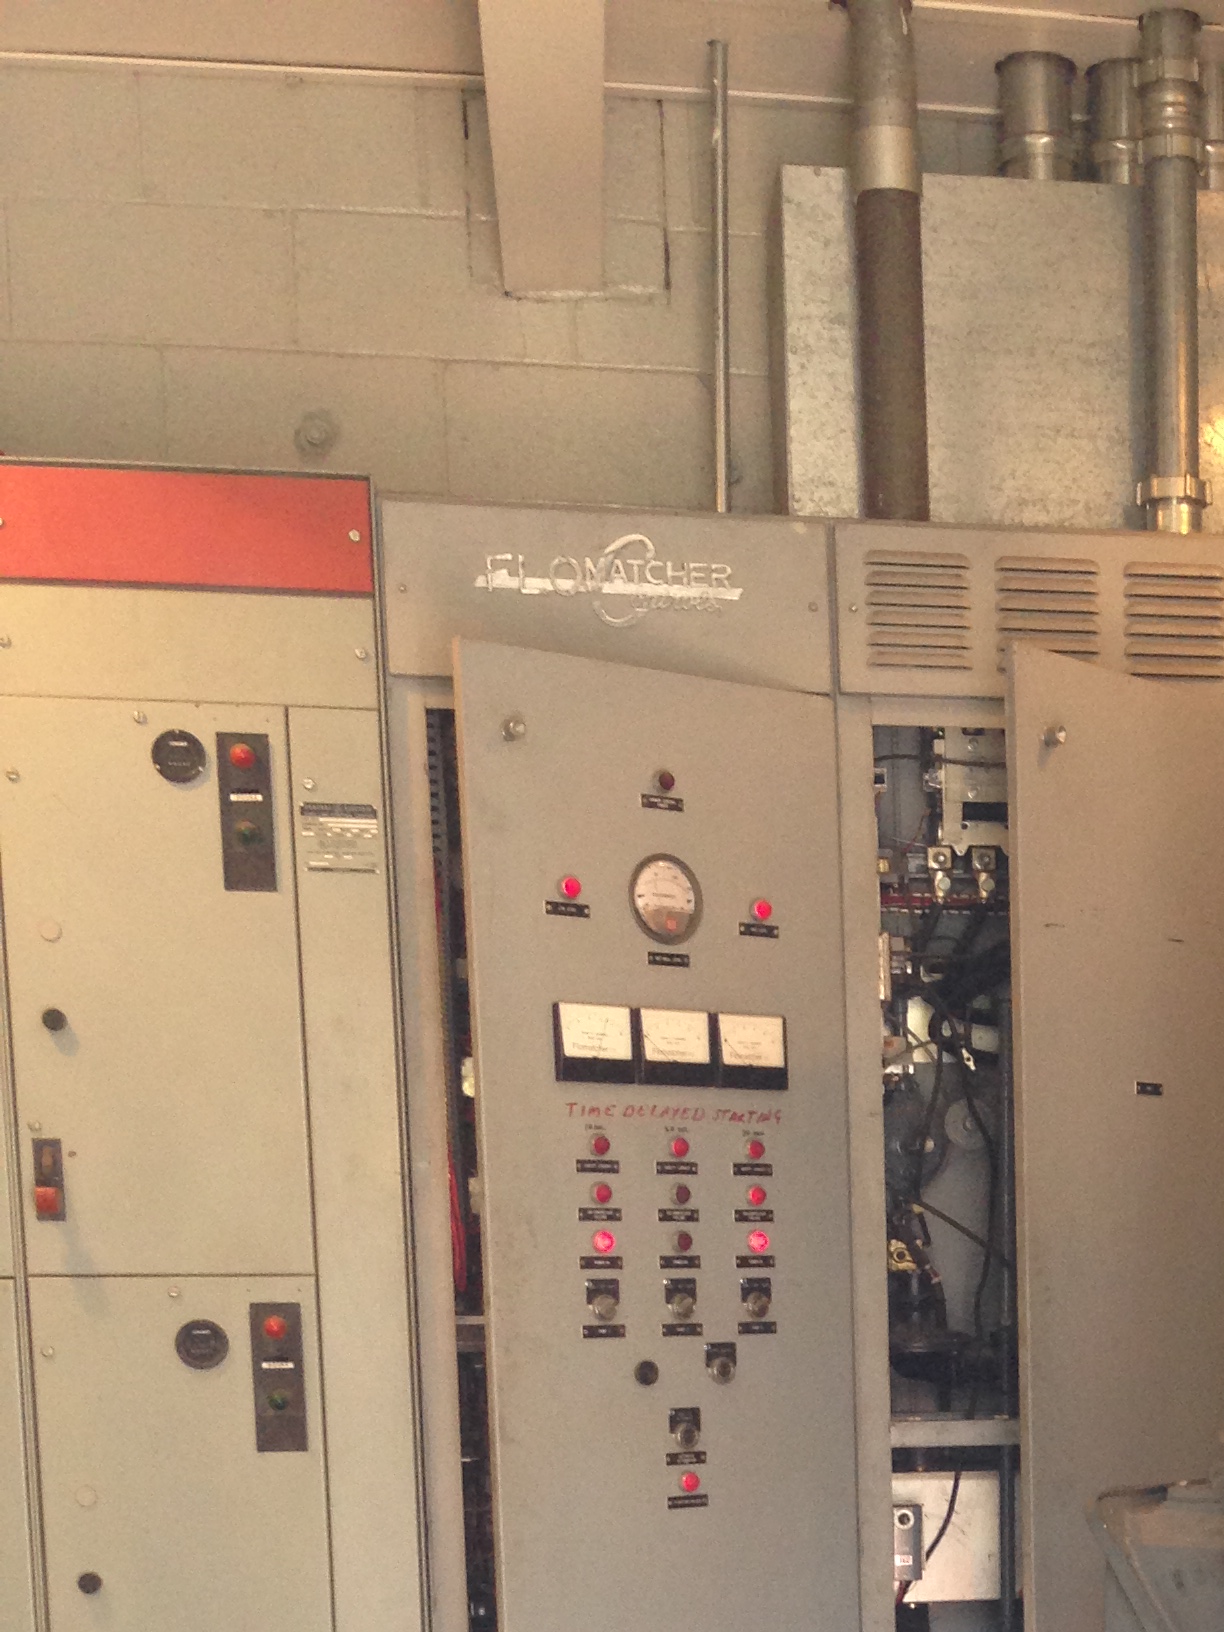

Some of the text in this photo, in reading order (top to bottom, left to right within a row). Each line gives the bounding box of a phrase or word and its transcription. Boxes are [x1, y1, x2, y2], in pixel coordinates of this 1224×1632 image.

[485, 552, 733, 596] FLOMATCHER
[565, 1102, 782, 1124] TIME DELAYED STARTING
